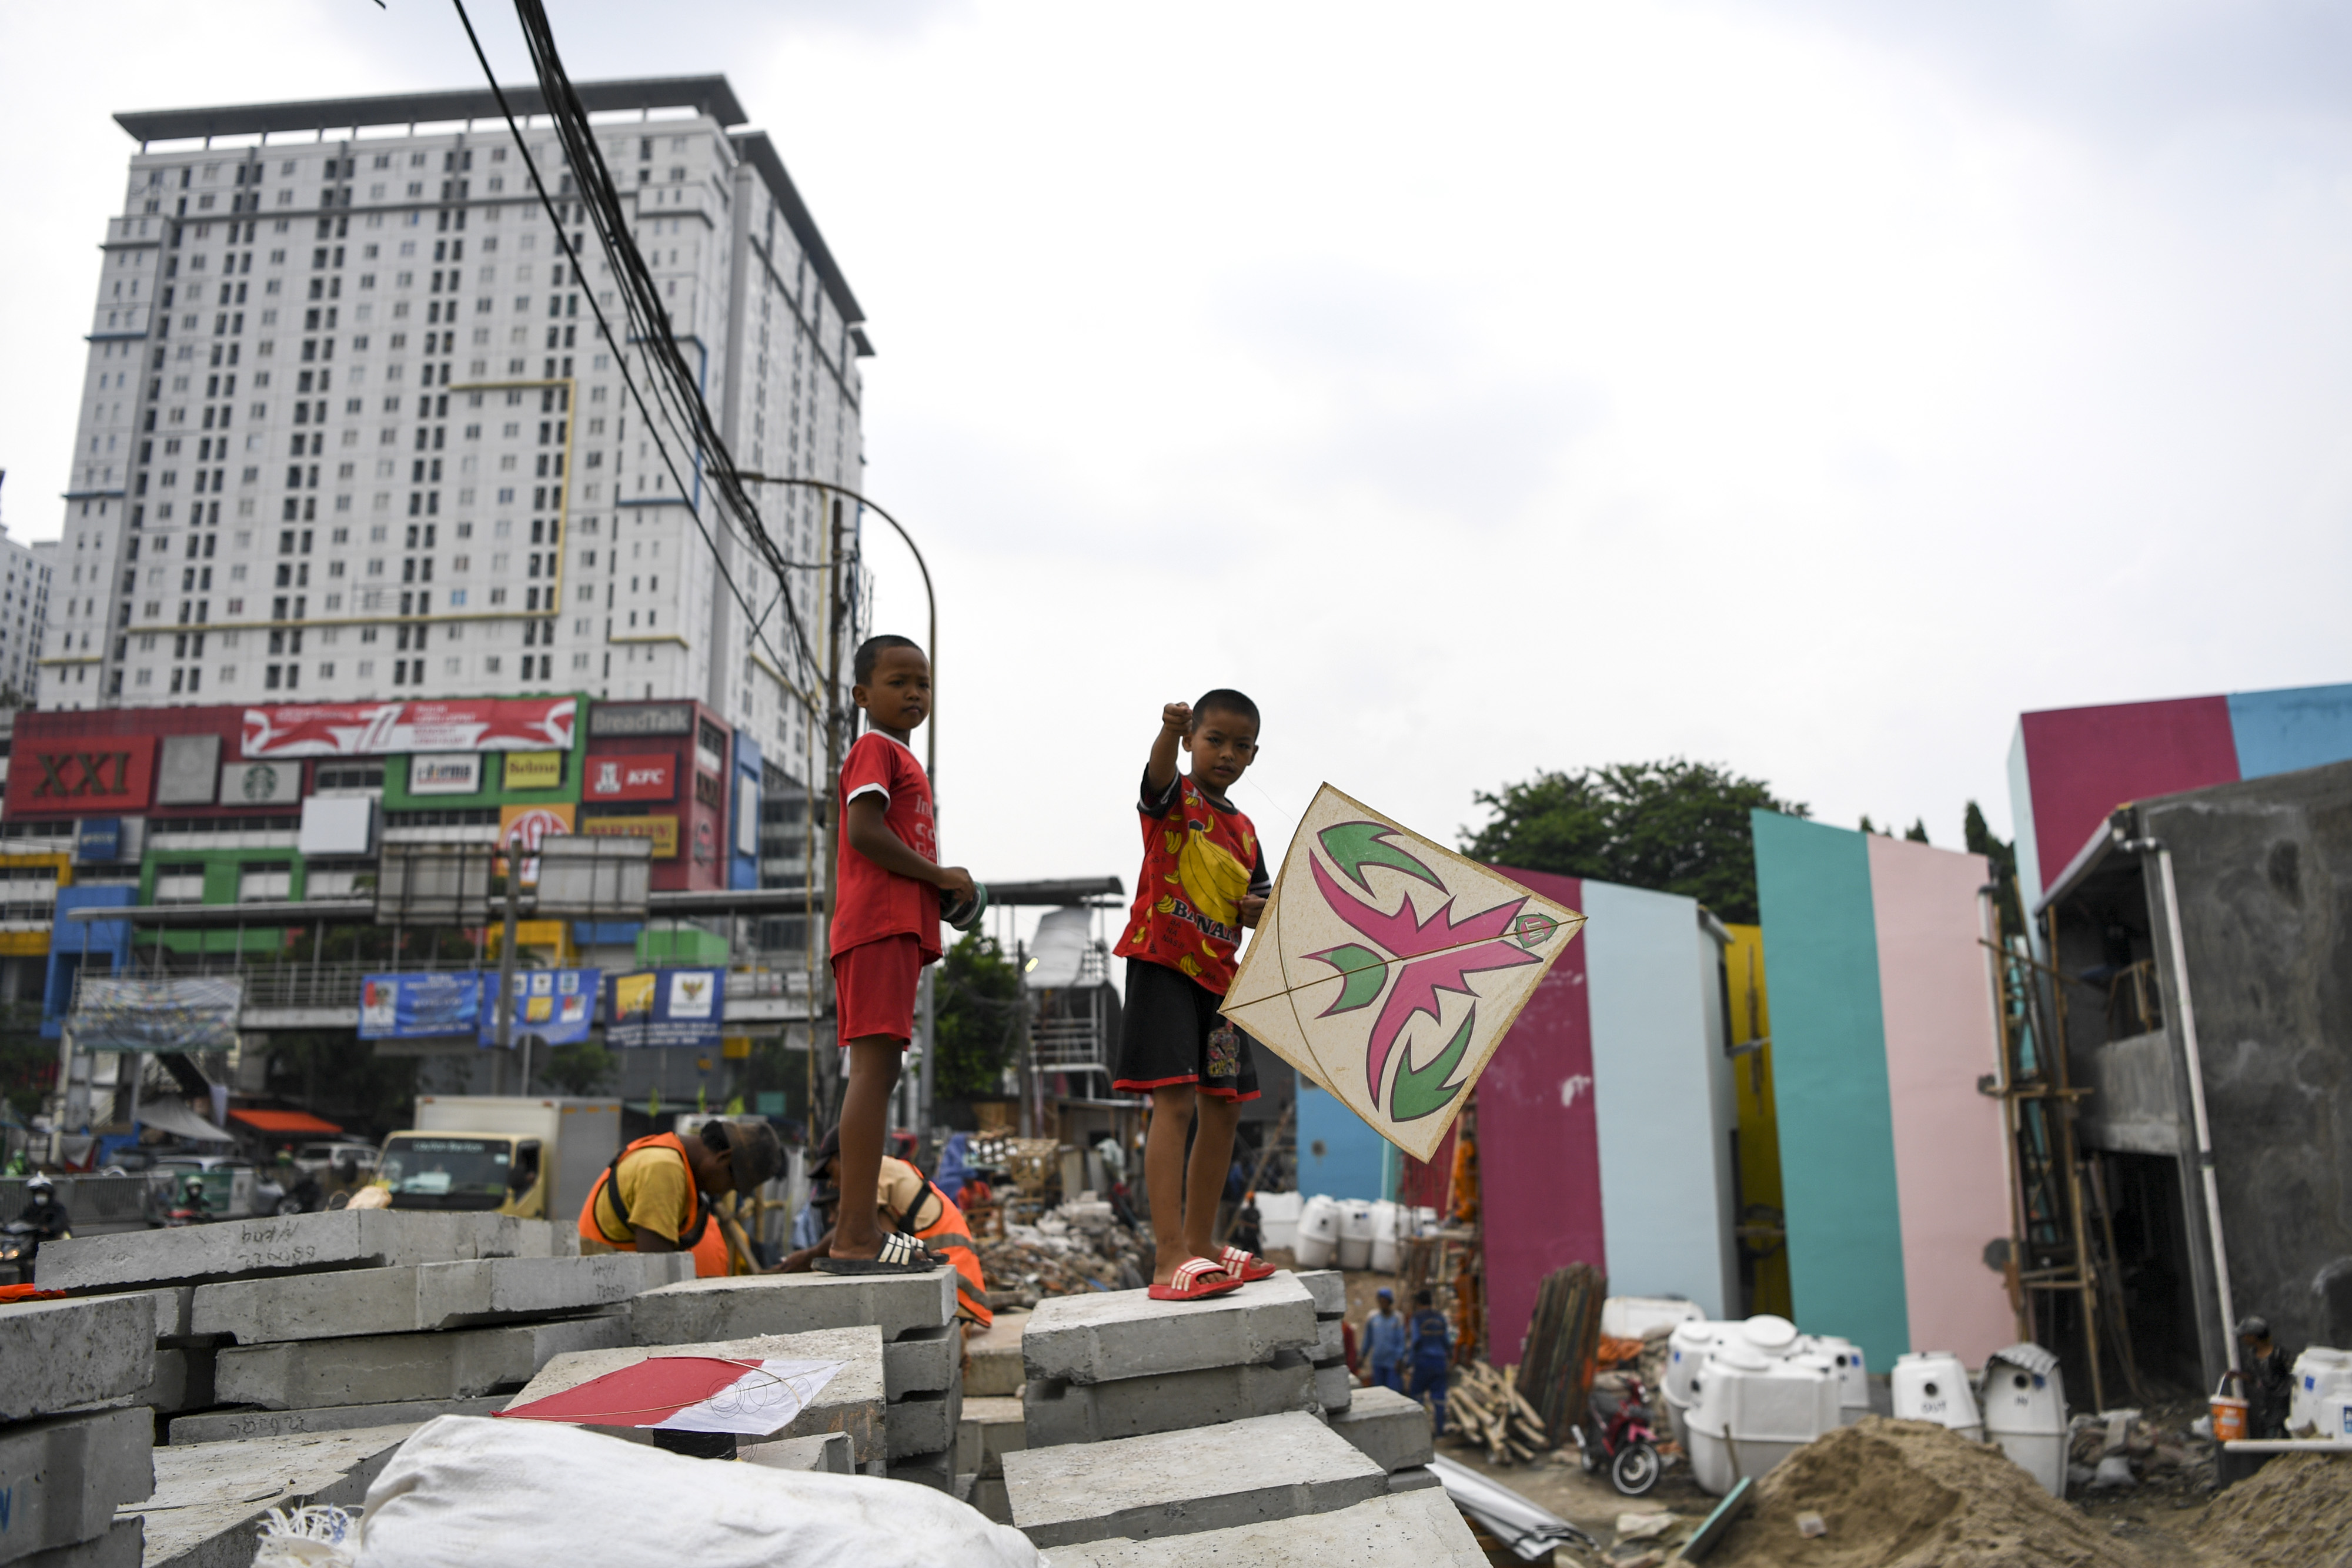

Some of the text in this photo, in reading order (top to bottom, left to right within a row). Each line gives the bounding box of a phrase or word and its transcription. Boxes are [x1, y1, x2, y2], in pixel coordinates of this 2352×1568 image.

[593, 708, 688, 733] BreadTalk
[32, 752, 131, 797] XXI
[627, 768, 666, 785] KFC
